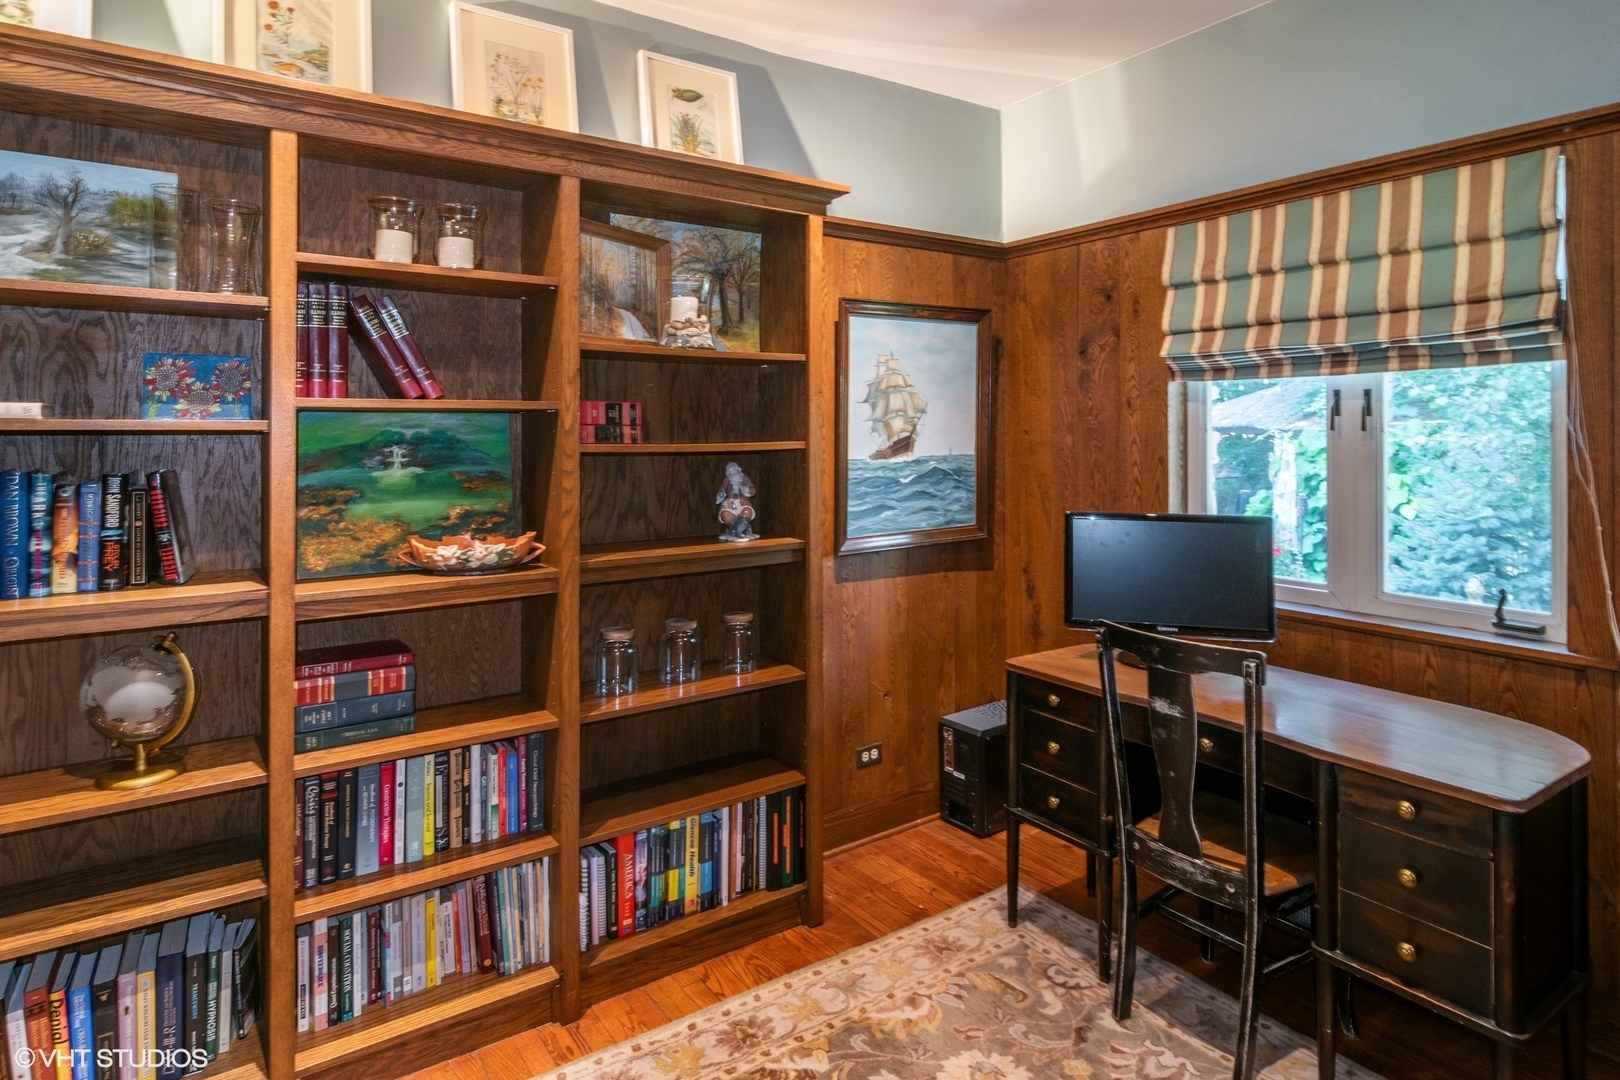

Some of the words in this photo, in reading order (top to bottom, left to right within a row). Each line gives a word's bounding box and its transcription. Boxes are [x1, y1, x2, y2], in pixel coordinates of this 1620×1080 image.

[6, 472, 20, 500] DAN
[37, 481, 47, 496] THE
[107, 473, 122, 494] JOHN
[31, 496, 47, 519] ARK
[105, 494, 122, 528] SANDFORD
[149, 489, 169, 529] CRICHTON
[5, 504, 20, 548] BROWN
[102, 541, 114, 572] PREY
[111, 543, 120, 570] STOLEN
[159, 545, 178, 581] MICHAEL
[4, 556, 20, 599] ORIGIN
[307, 786, 320, 815] Crisis
[383, 783, 391, 817] Constructive
[381, 817, 391, 844] Therapies
[689, 817, 697, 849] Glencoe
[624, 853, 634, 900] AMERICA
[342, 928, 352, 954] SOCIAL
[316, 944, 325, 988] BIOFEEDBACK
[343, 955, 352, 994] COGNITION
[190, 983, 198, 1020] TRANCEWORK
[50, 998, 69, 1046] Denial
[206, 1000, 217, 1042] HYPNOSIS
